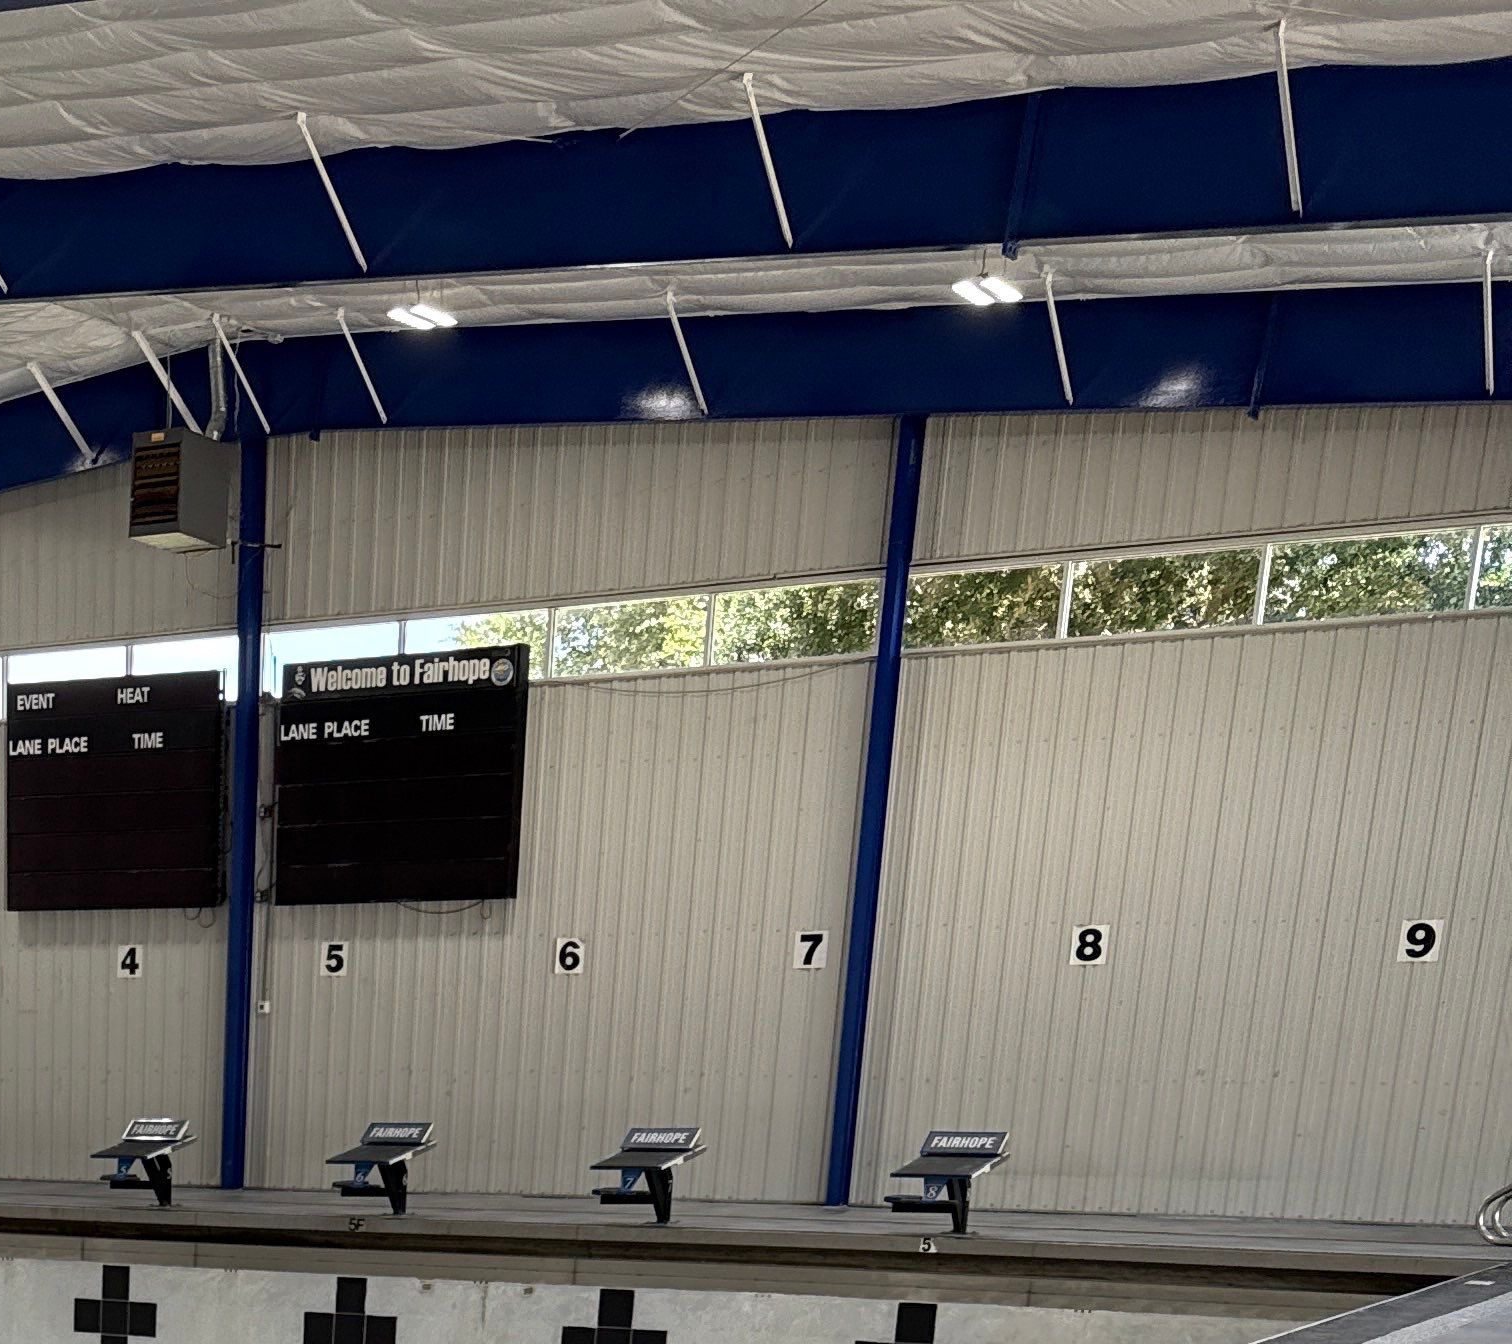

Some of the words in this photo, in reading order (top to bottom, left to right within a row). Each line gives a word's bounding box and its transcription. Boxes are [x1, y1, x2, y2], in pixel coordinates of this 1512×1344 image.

[310, 665, 387, 693] Welcome
[391, 661, 411, 686] to
[413, 656, 491, 685] Fairhope
[16, 692, 56, 711] EVENT
[117, 686, 151, 705] HEAT
[281, 722, 318, 741] LANE
[324, 719, 370, 739] PLACE
[419, 713, 455, 732] TIME
[9, 739, 42, 756] LANE
[47, 736, 88, 754] PLACE
[132, 731, 164, 749] TIME
[799, 933, 824, 966] 7
[1075, 928, 1103, 962] 8
[1405, 922, 1436, 959] 9
[121, 947, 140, 975] 4
[325, 944, 344, 973] 5
[559, 940, 580, 971] 6
[131, 1124, 179, 1135] FAIRHOPE
[369, 1128, 423, 1138] FAIRHOPE
[630, 1132, 690, 1143] FAIRHOPE
[930, 1136, 997, 1149] FAIRHOPE
[356, 1172, 364, 1183] 6
[624, 1177, 634, 1189] 7
[927, 1185, 938, 1199] 8
[922, 1237, 932, 1252] 5
